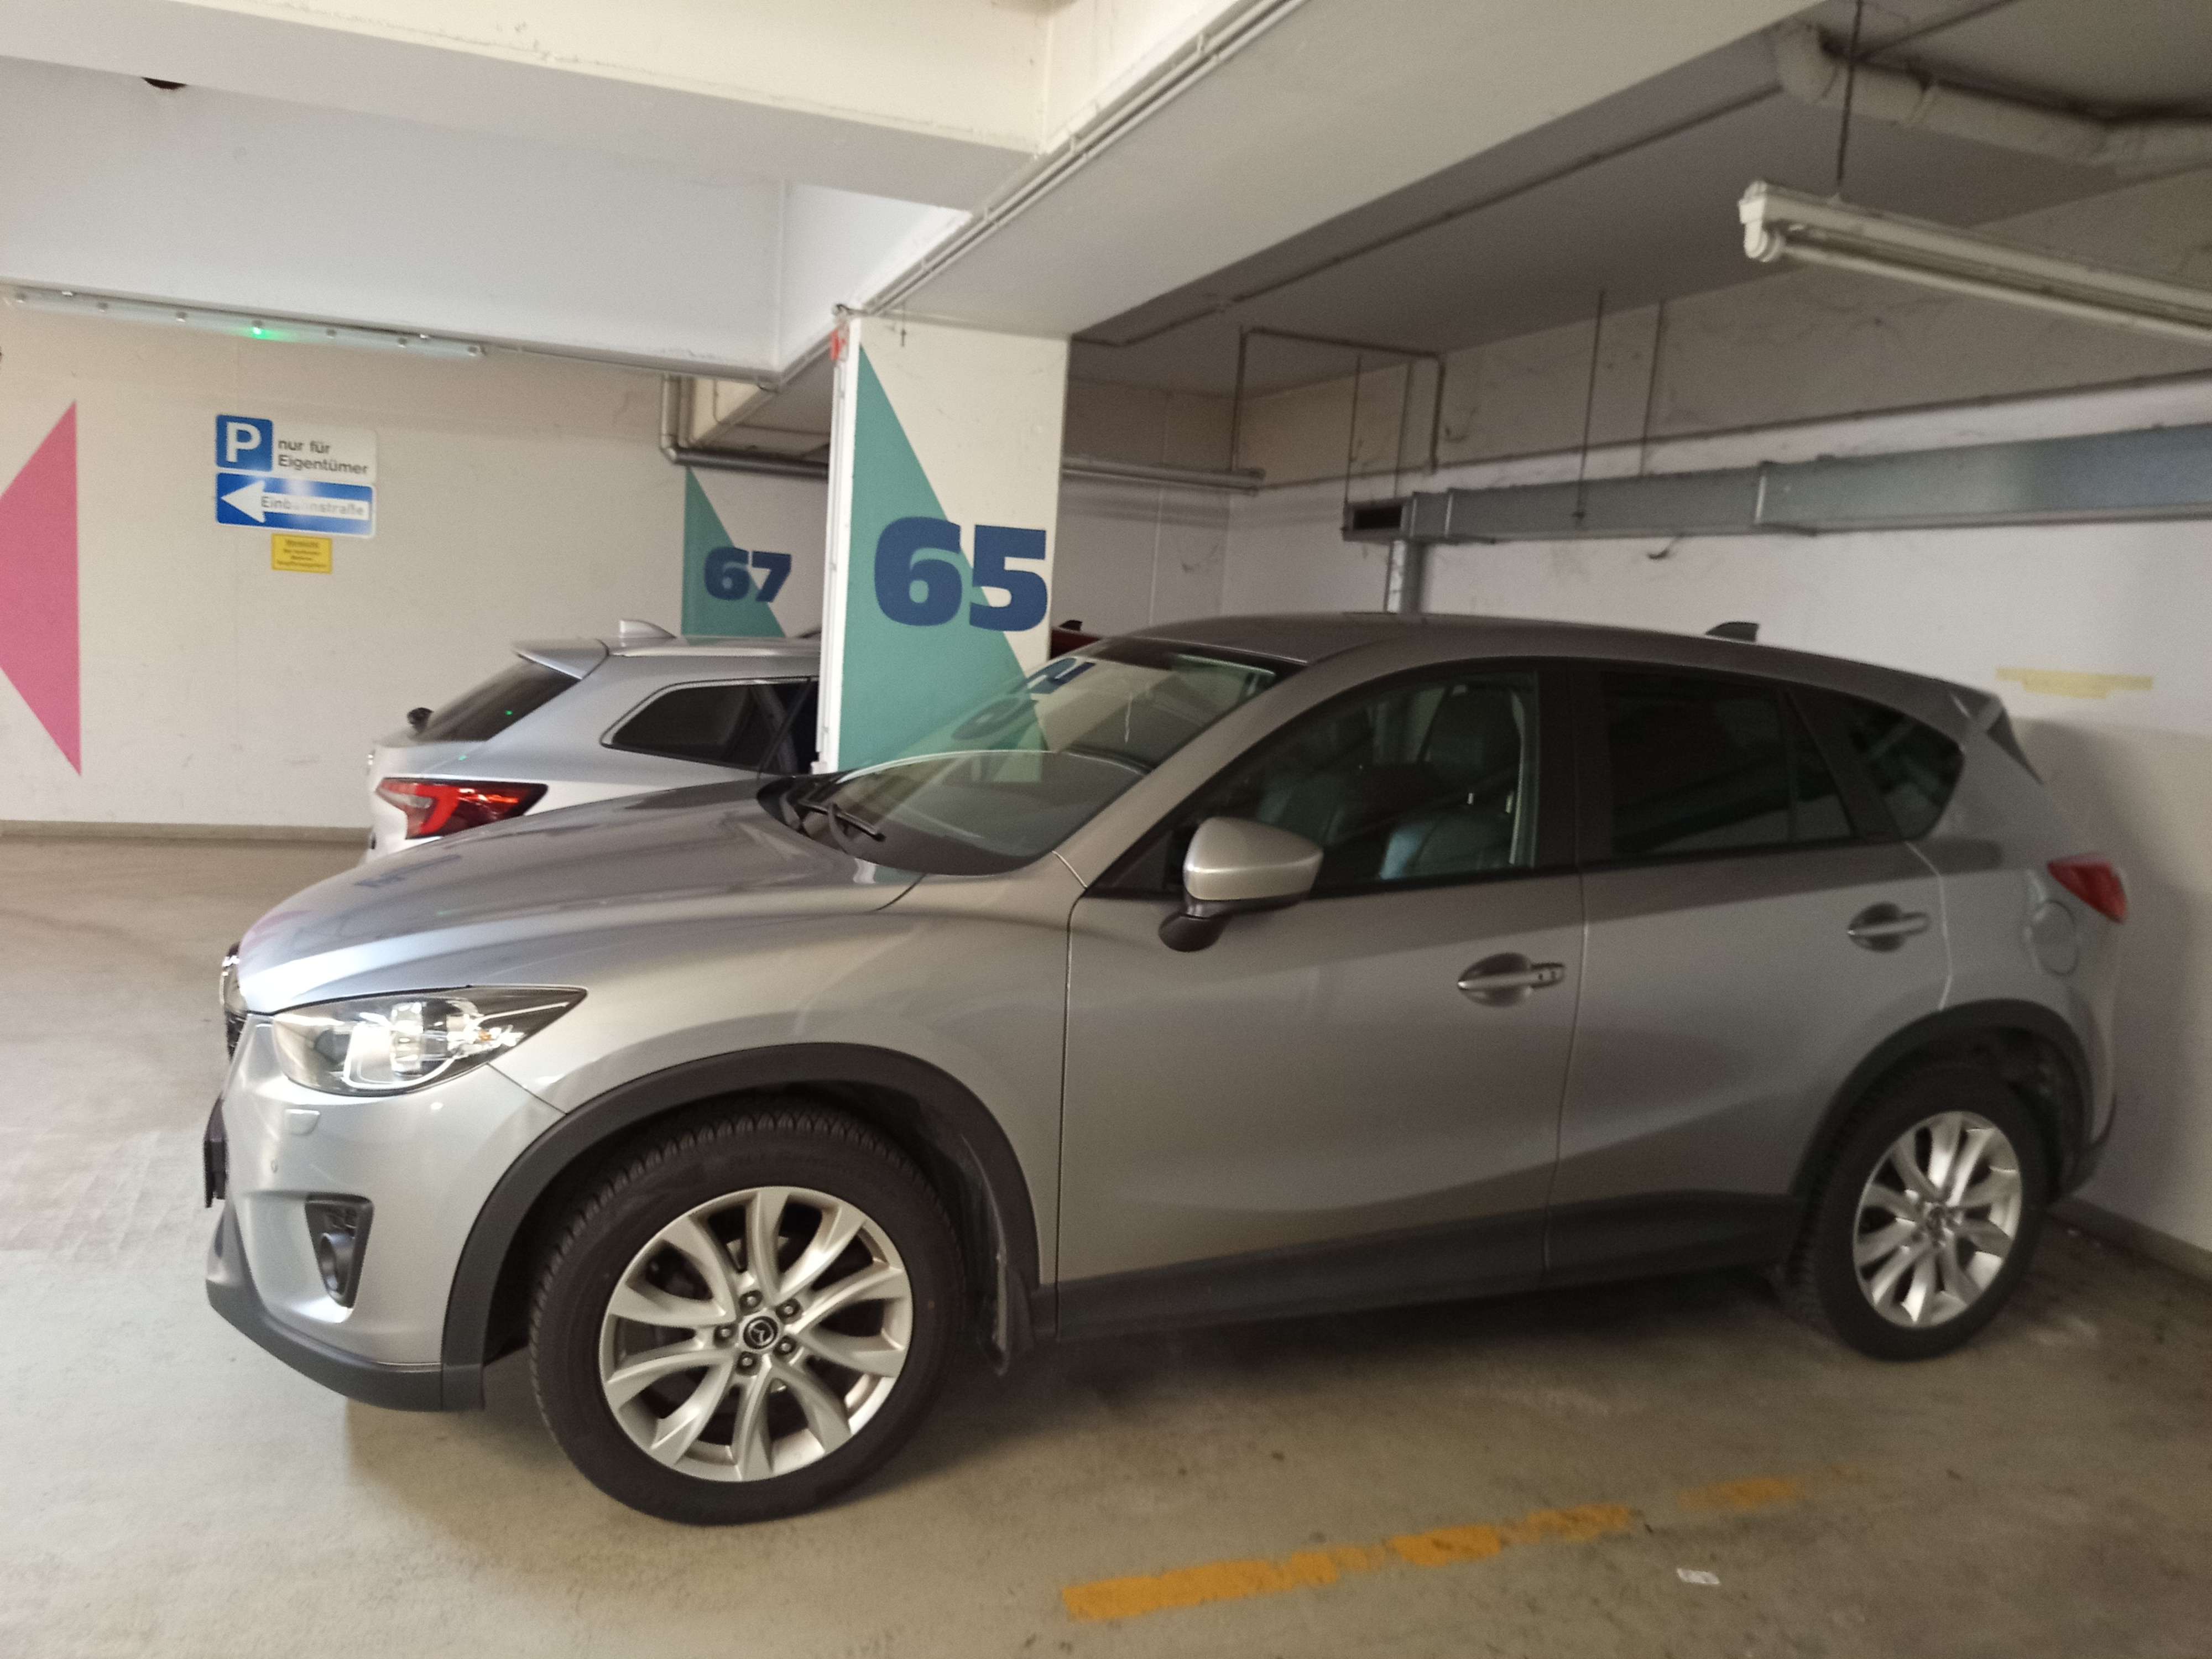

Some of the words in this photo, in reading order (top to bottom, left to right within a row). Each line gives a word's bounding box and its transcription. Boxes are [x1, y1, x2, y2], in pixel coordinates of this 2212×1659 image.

[226, 421, 262, 463] P
[278, 440, 304, 451] nur
[310, 440, 330, 453] für
[278, 454, 368, 474] Eigentümer
[260, 495, 364, 516] Einbnstraße
[704, 546, 792, 603] 67
[874, 516, 1048, 632] 65
